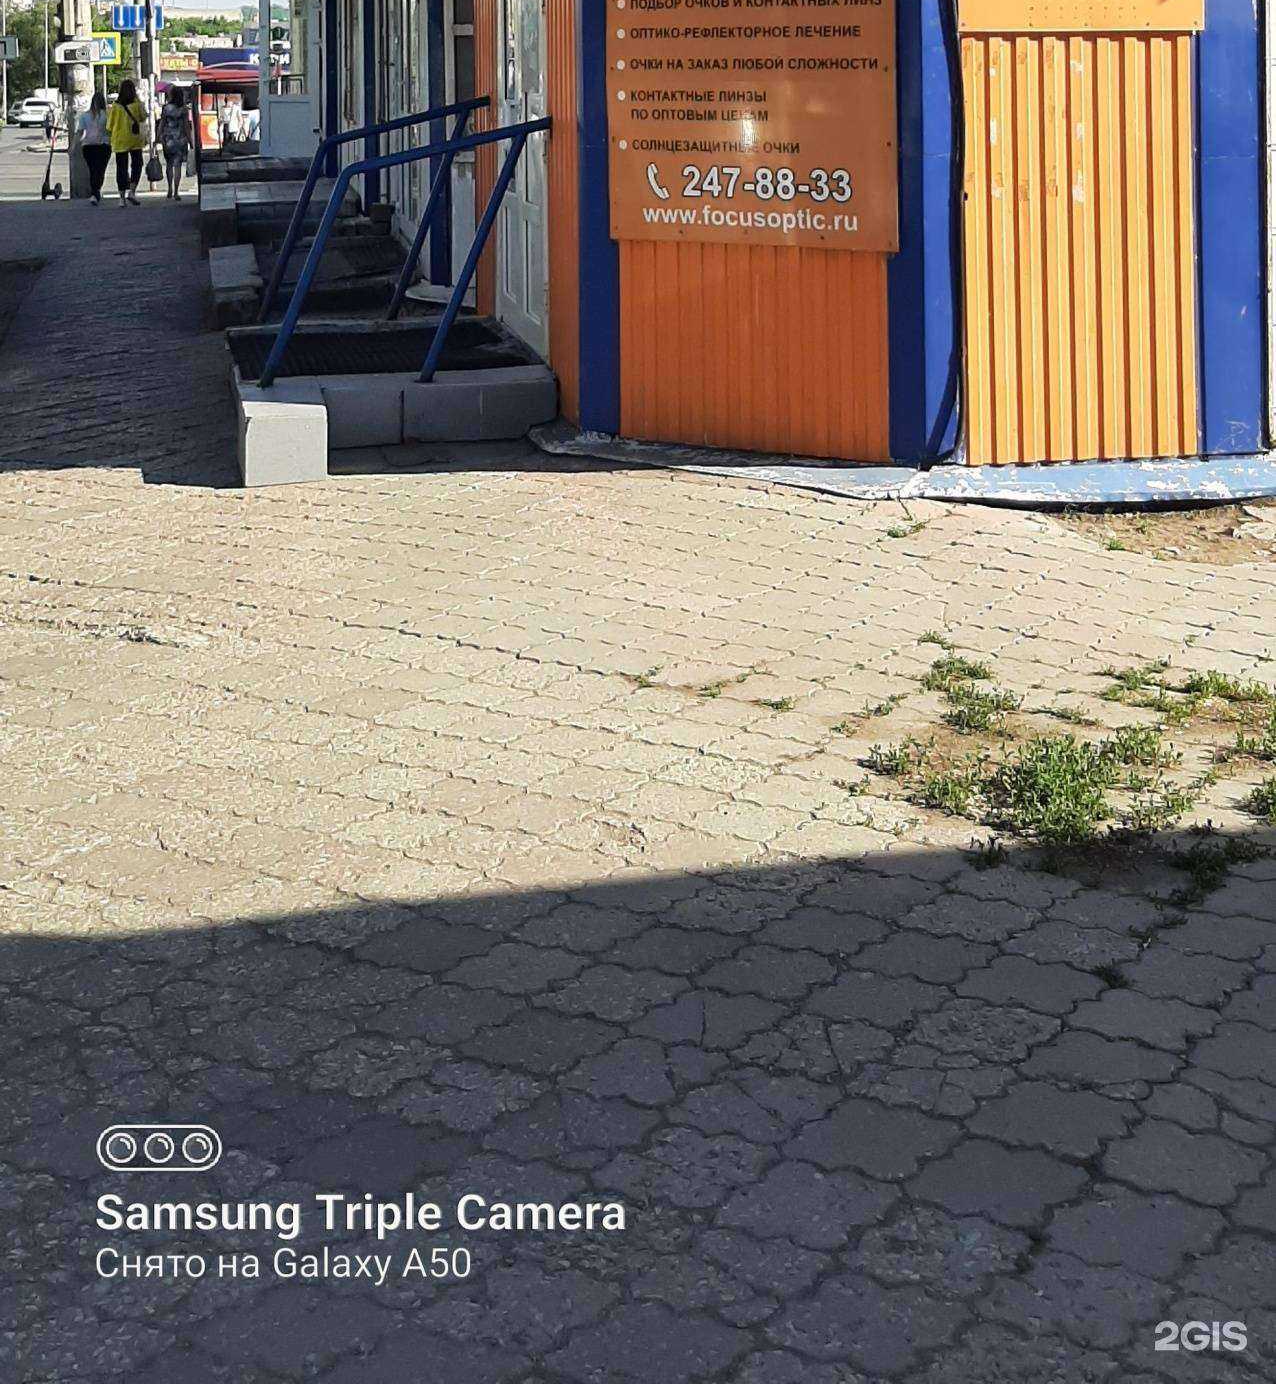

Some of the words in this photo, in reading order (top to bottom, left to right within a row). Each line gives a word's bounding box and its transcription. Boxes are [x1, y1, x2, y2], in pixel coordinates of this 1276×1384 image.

[630, 26, 791, 39] ОПТИКО-РЕФЛЕКТОРНОЕ
[795, 25, 861, 38] ЛЕЧЕНИЕ
[630, 58, 663, 71] ОЧКИ
[667, 58, 684, 70] НА
[688, 58, 729, 70] ЗАКАЗ
[732, 55, 784, 70] ЛЮБОЙ
[788, 57, 878, 70] СЛОЖНОСТИ
[630, 90, 715, 102] КОНТАКТНЫЕ
[718, 90, 767, 102] ЛИНЗЫ
[631, 109, 649, 121] ПО
[652, 109, 717, 121] ОПТОВЫМ
[763, 142, 800, 154] ОЧКИ
[681, 165, 851, 202] 247-88-33
[643, 205, 858, 233] www.focusoptic.ru
